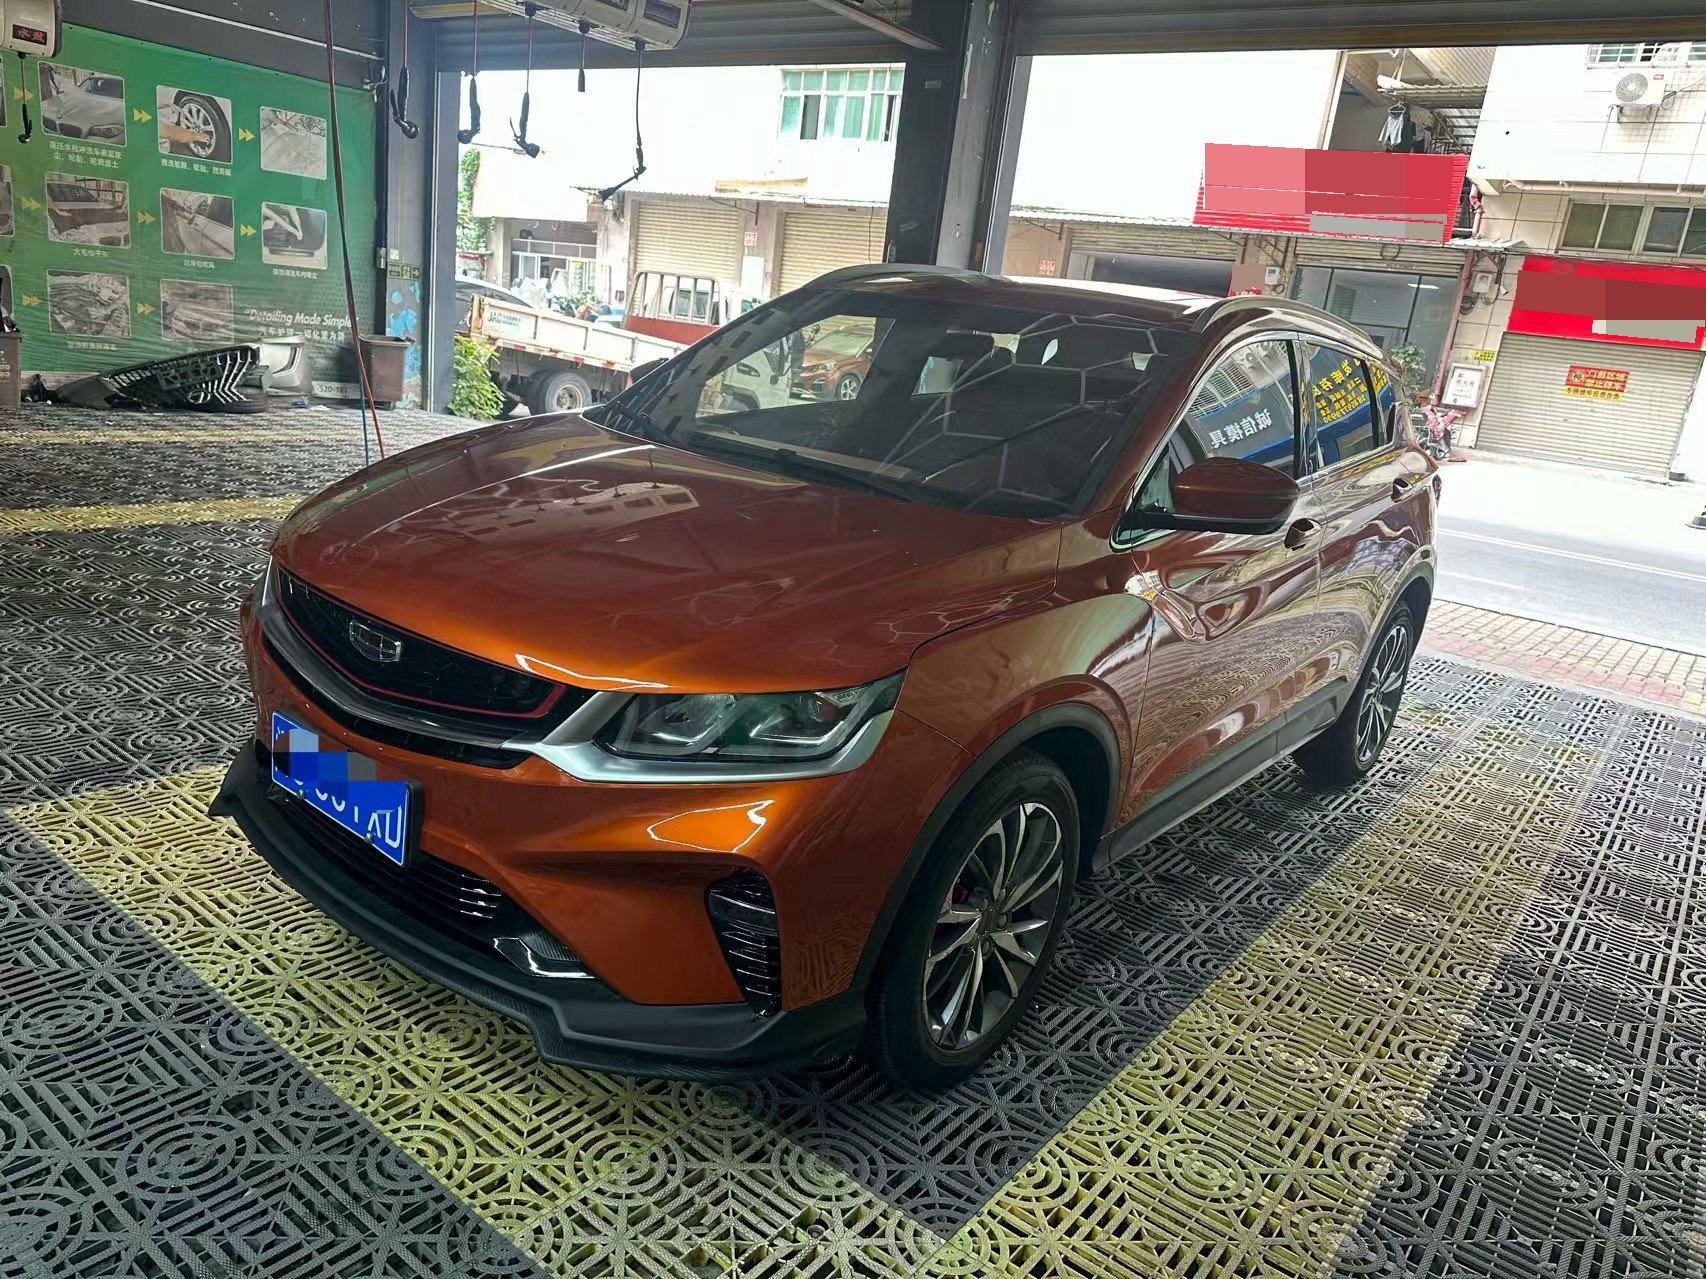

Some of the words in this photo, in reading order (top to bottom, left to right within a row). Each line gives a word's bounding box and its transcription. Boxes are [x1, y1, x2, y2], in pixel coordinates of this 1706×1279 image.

[294, 312, 321, 325] Made
[1586, 379, 1622, 390] 禁止停车
